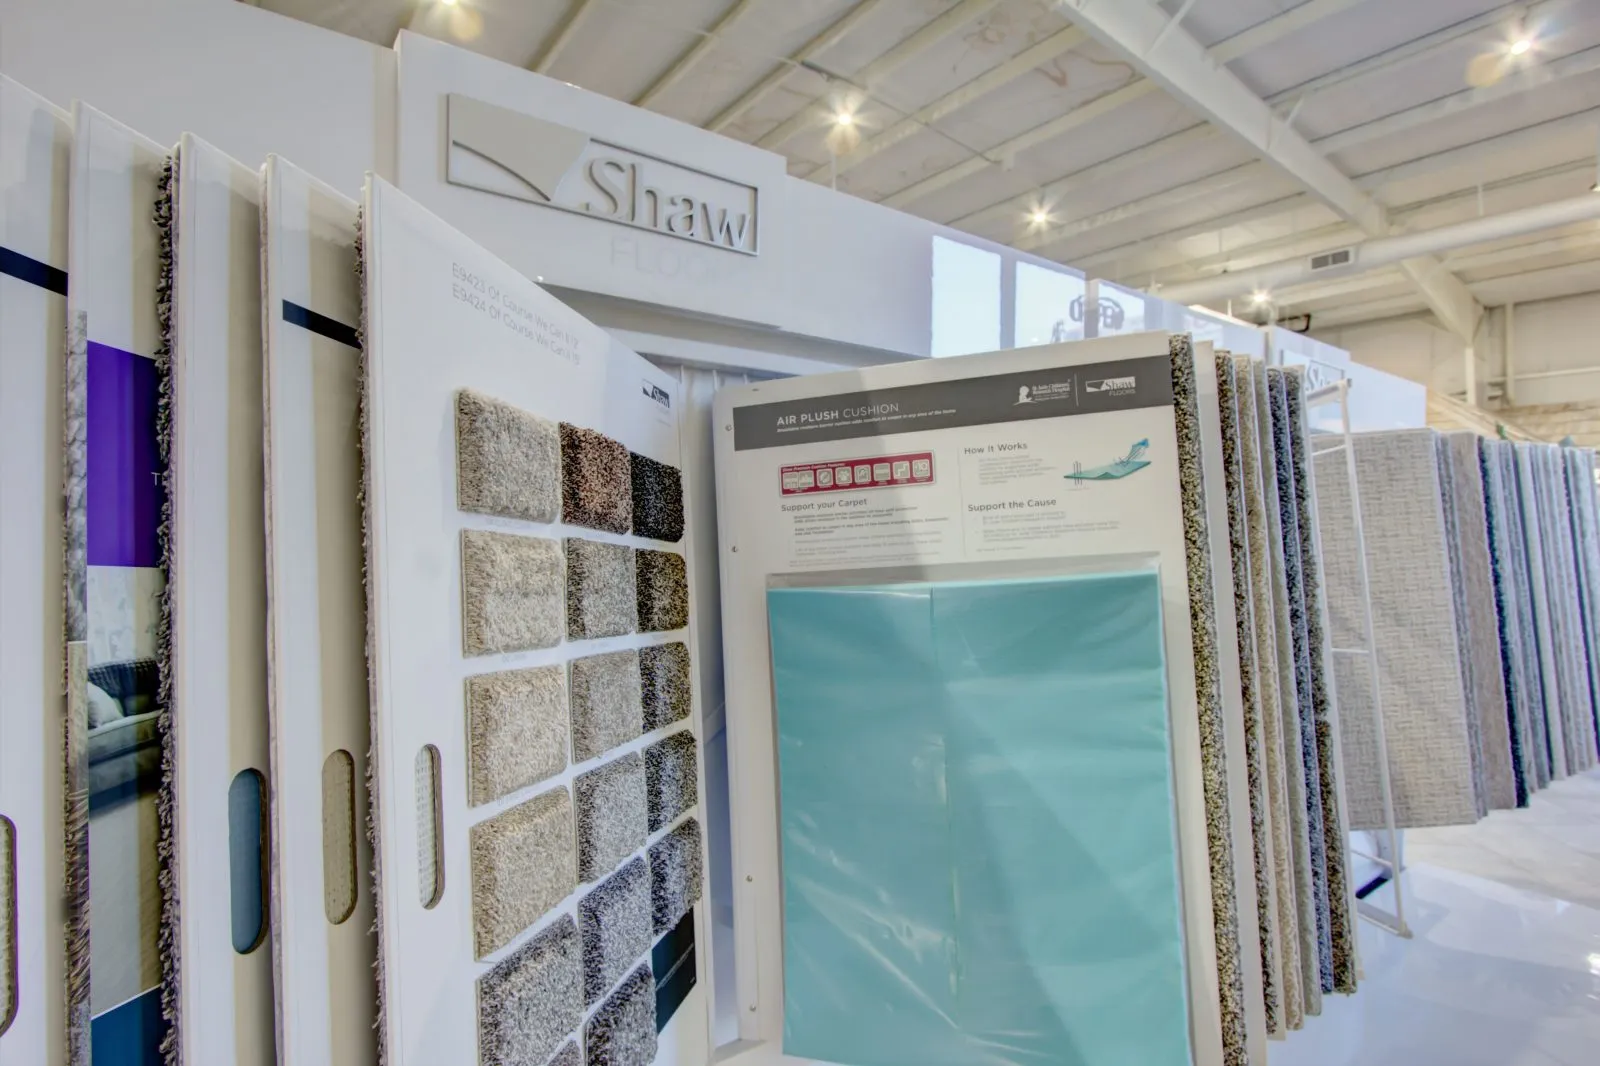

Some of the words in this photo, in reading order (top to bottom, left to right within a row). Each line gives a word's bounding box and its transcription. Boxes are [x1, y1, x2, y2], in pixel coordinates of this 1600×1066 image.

[583, 157, 752, 249] Shaw
[452, 262, 486, 294] E9423
[488, 285, 501, 303] Of
[502, 294, 534, 322] Course
[534, 313, 549, 332] We
[452, 283, 487, 312] E9424
[488, 304, 501, 323] Of
[502, 313, 535, 341] Course
[534, 331, 550, 350] We
[1104, 379, 1136, 391] Shaw
[1108, 388, 1137, 397] FLOORS
[653, 387, 669, 408] Shaw
[776, 415, 798, 427] AIR
[800, 410, 839, 424] PLUSH
[842, 402, 900, 419] CUSHION
[963, 446, 985, 455] How
[987, 444, 995, 453] It
[997, 442, 1028, 453] Works
[780, 502, 815, 513] Support
[816, 501, 836, 511] your
[838, 497, 868, 508] Carpet
[967, 502, 1006, 512] Support
[1008, 500, 1025, 510] the
[1027, 498, 1057, 508] Cause
